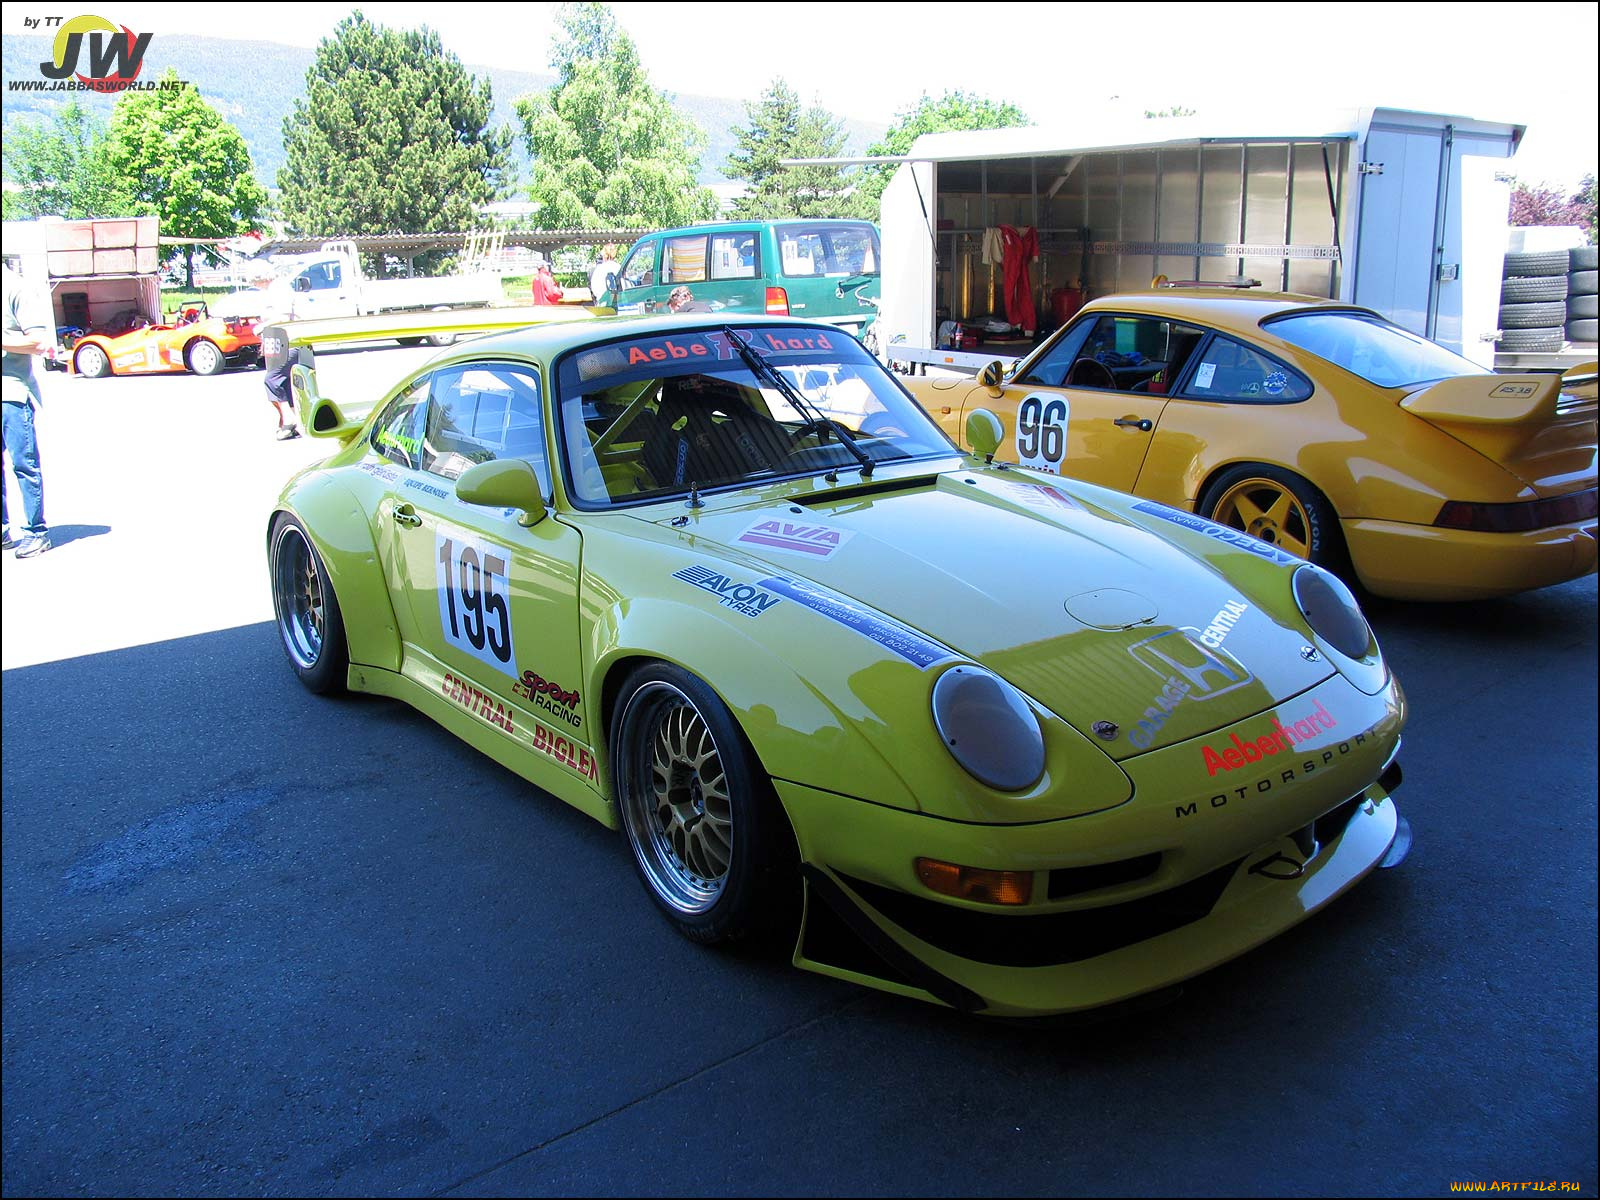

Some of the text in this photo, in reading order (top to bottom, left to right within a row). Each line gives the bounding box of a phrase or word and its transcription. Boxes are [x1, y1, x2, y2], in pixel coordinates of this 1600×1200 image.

[1018, 397, 1067, 463] 96
[752, 520, 841, 545] AVIA
[1304, 503, 1320, 551] AVON
[440, 538, 511, 663] 195
[699, 574, 781, 611] AVON
[719, 597, 762, 618] TYRES
[1200, 600, 1249, 649] CENTRAL
[441, 673, 515, 733] CENTRAL
[535, 695, 582, 728] RACING
[1127, 675, 1191, 750] GARAGE
[1201, 698, 1337, 777] Aeberhard
[1175, 728, 1375, 818] MOTORSPORT
